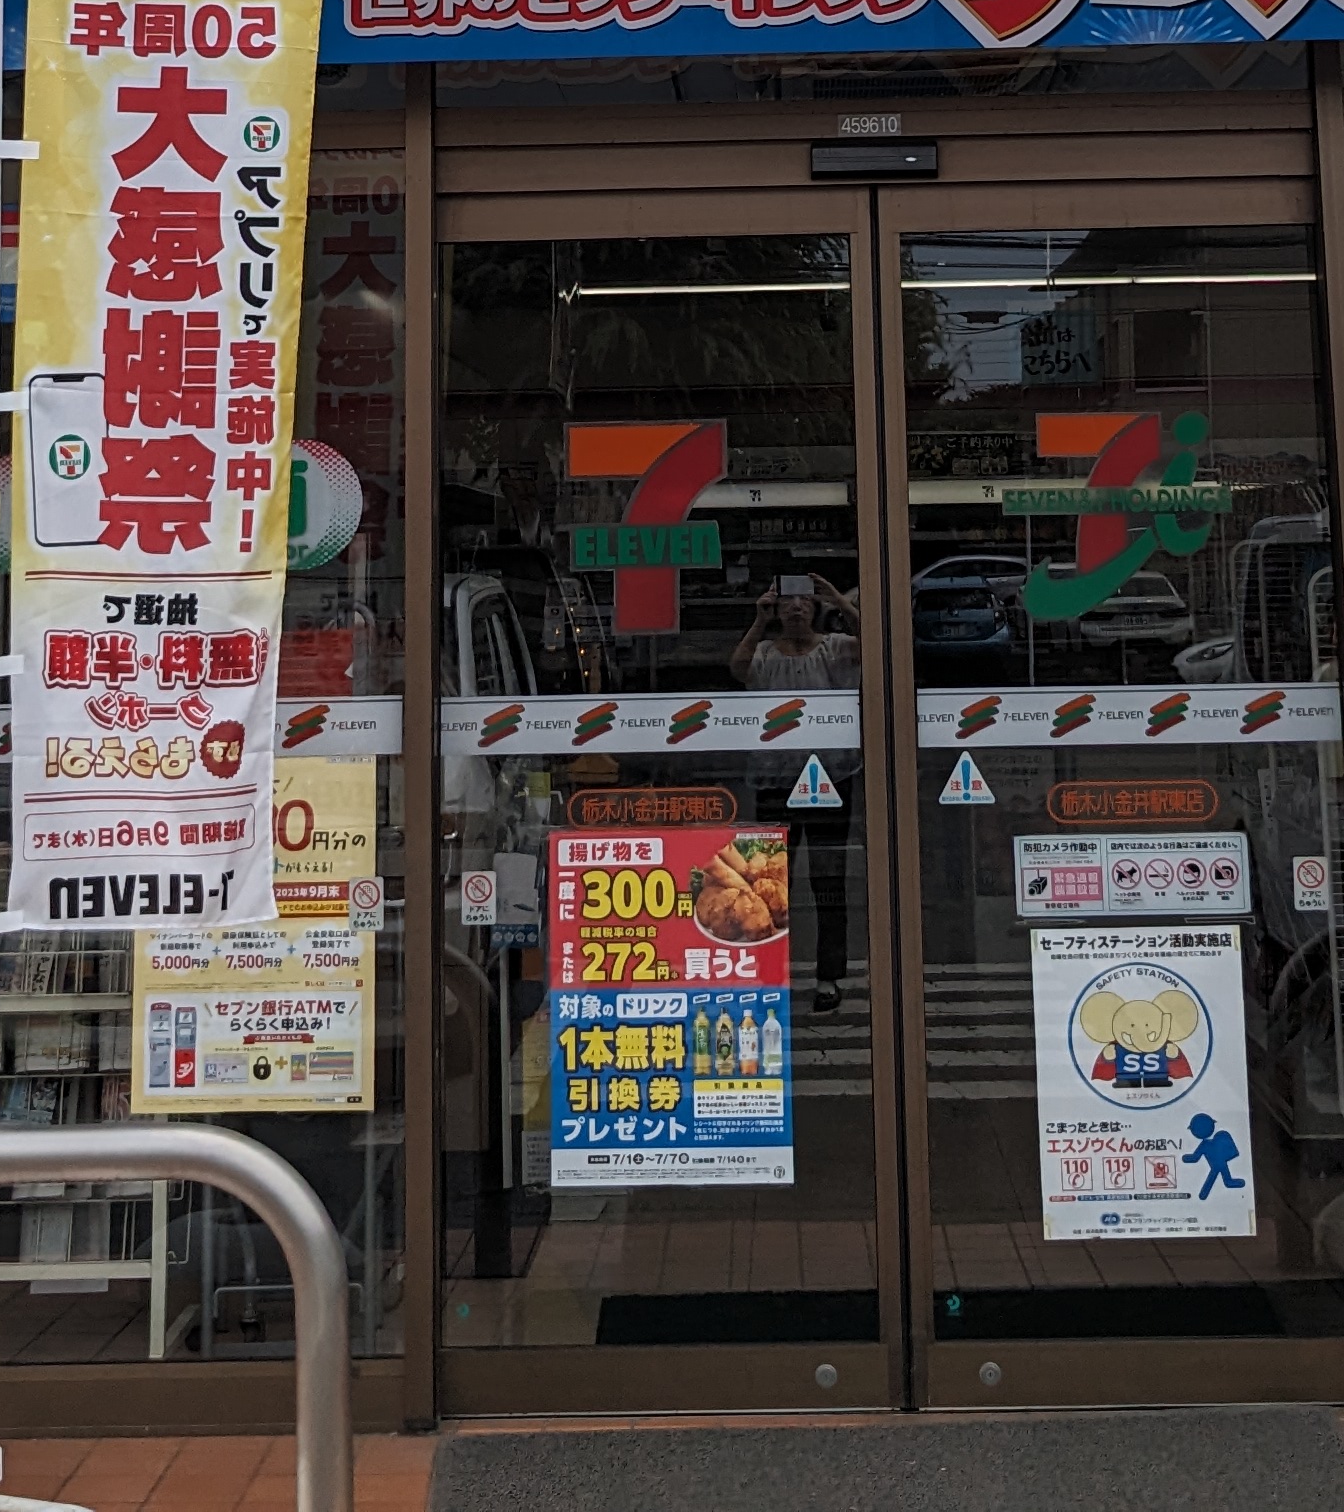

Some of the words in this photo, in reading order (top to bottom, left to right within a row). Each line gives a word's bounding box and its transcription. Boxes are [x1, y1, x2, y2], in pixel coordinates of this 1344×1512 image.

[841, 117, 899, 136] 459610
[581, 796, 724, 823] 栃木小金井駅東店
[1061, 788, 1205, 816] 栃木小金井駅東店
[568, 842, 653, 863] 揚げ物を
[1023, 842, 1098, 853] 防犯カメラ作動中
[558, 871, 576, 921] 一度に
[1039, 932, 1233, 951] セーフティステーション活動実施店
[151, 954, 210, 970] 5,000円分
[225, 954, 283, 969] 7,500円分
[302, 953, 360, 968] 7,500円分
[562, 942, 574, 984] または
[684, 948, 757, 980] 買うと
[1095, 967, 1133, 991] SAFETY
[1135, 967, 1181, 989] STATION
[214, 999, 347, 1017] セブン銀行ATMで
[229, 1016, 331, 1032] らくらく申込み!
[559, 1024, 686, 1072] 1本無料
[1122, 1053, 1161, 1072] SS
[568, 1077, 681, 1112] 引換券
[561, 1115, 688, 1143] プレゼント
[1046, 1137, 1183, 1154] エスゾウくんのお店へ!
[1063, 1159, 1089, 1175] 110
[1105, 1158, 1131, 1174] 119
